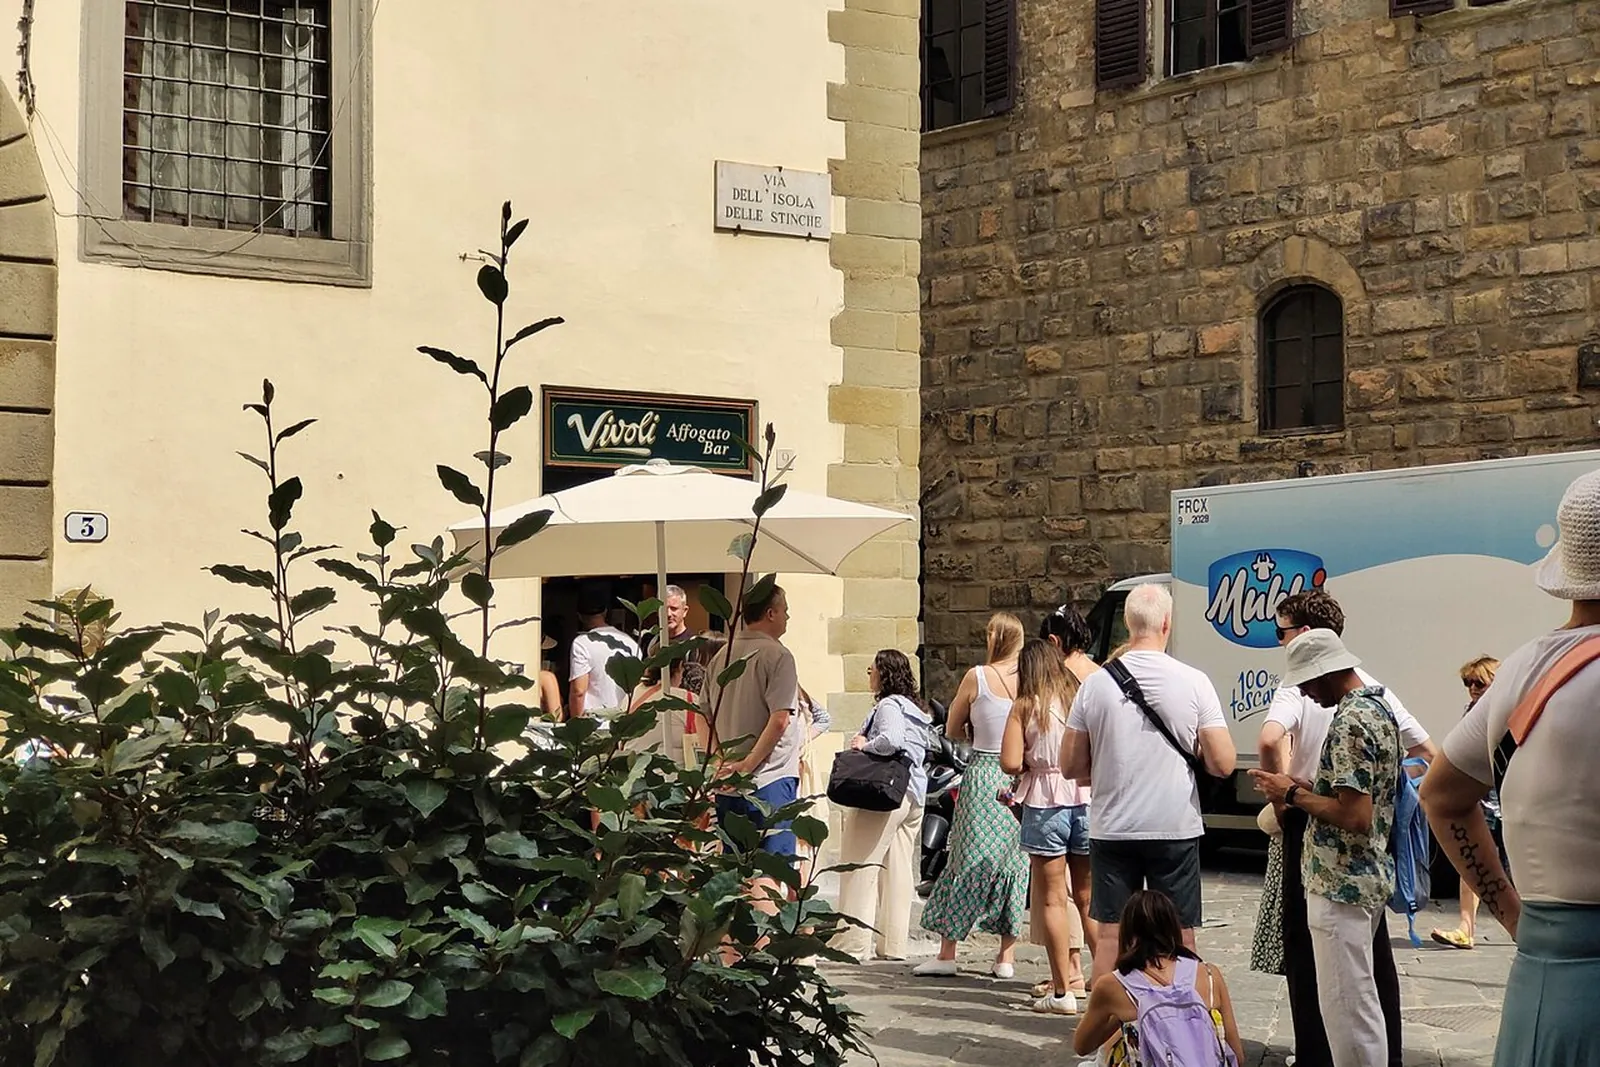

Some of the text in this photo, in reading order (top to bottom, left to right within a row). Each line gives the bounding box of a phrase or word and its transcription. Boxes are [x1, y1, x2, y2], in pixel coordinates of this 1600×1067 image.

[763, 174, 787, 188] VIA
[732, 187, 815, 209] DELL' ISOLA
[725, 205, 822, 229] DELLE STINCHE
[567, 410, 731, 453] Vivoli Affogato
[703, 441, 729, 456] Bar
[1178, 498, 1208, 514] FRCX
[81, 517, 95, 537] 3
[1177, 515, 1184, 525] 9
[1205, 567, 1327, 638] Muk
[1238, 669, 1280, 700] 100%
